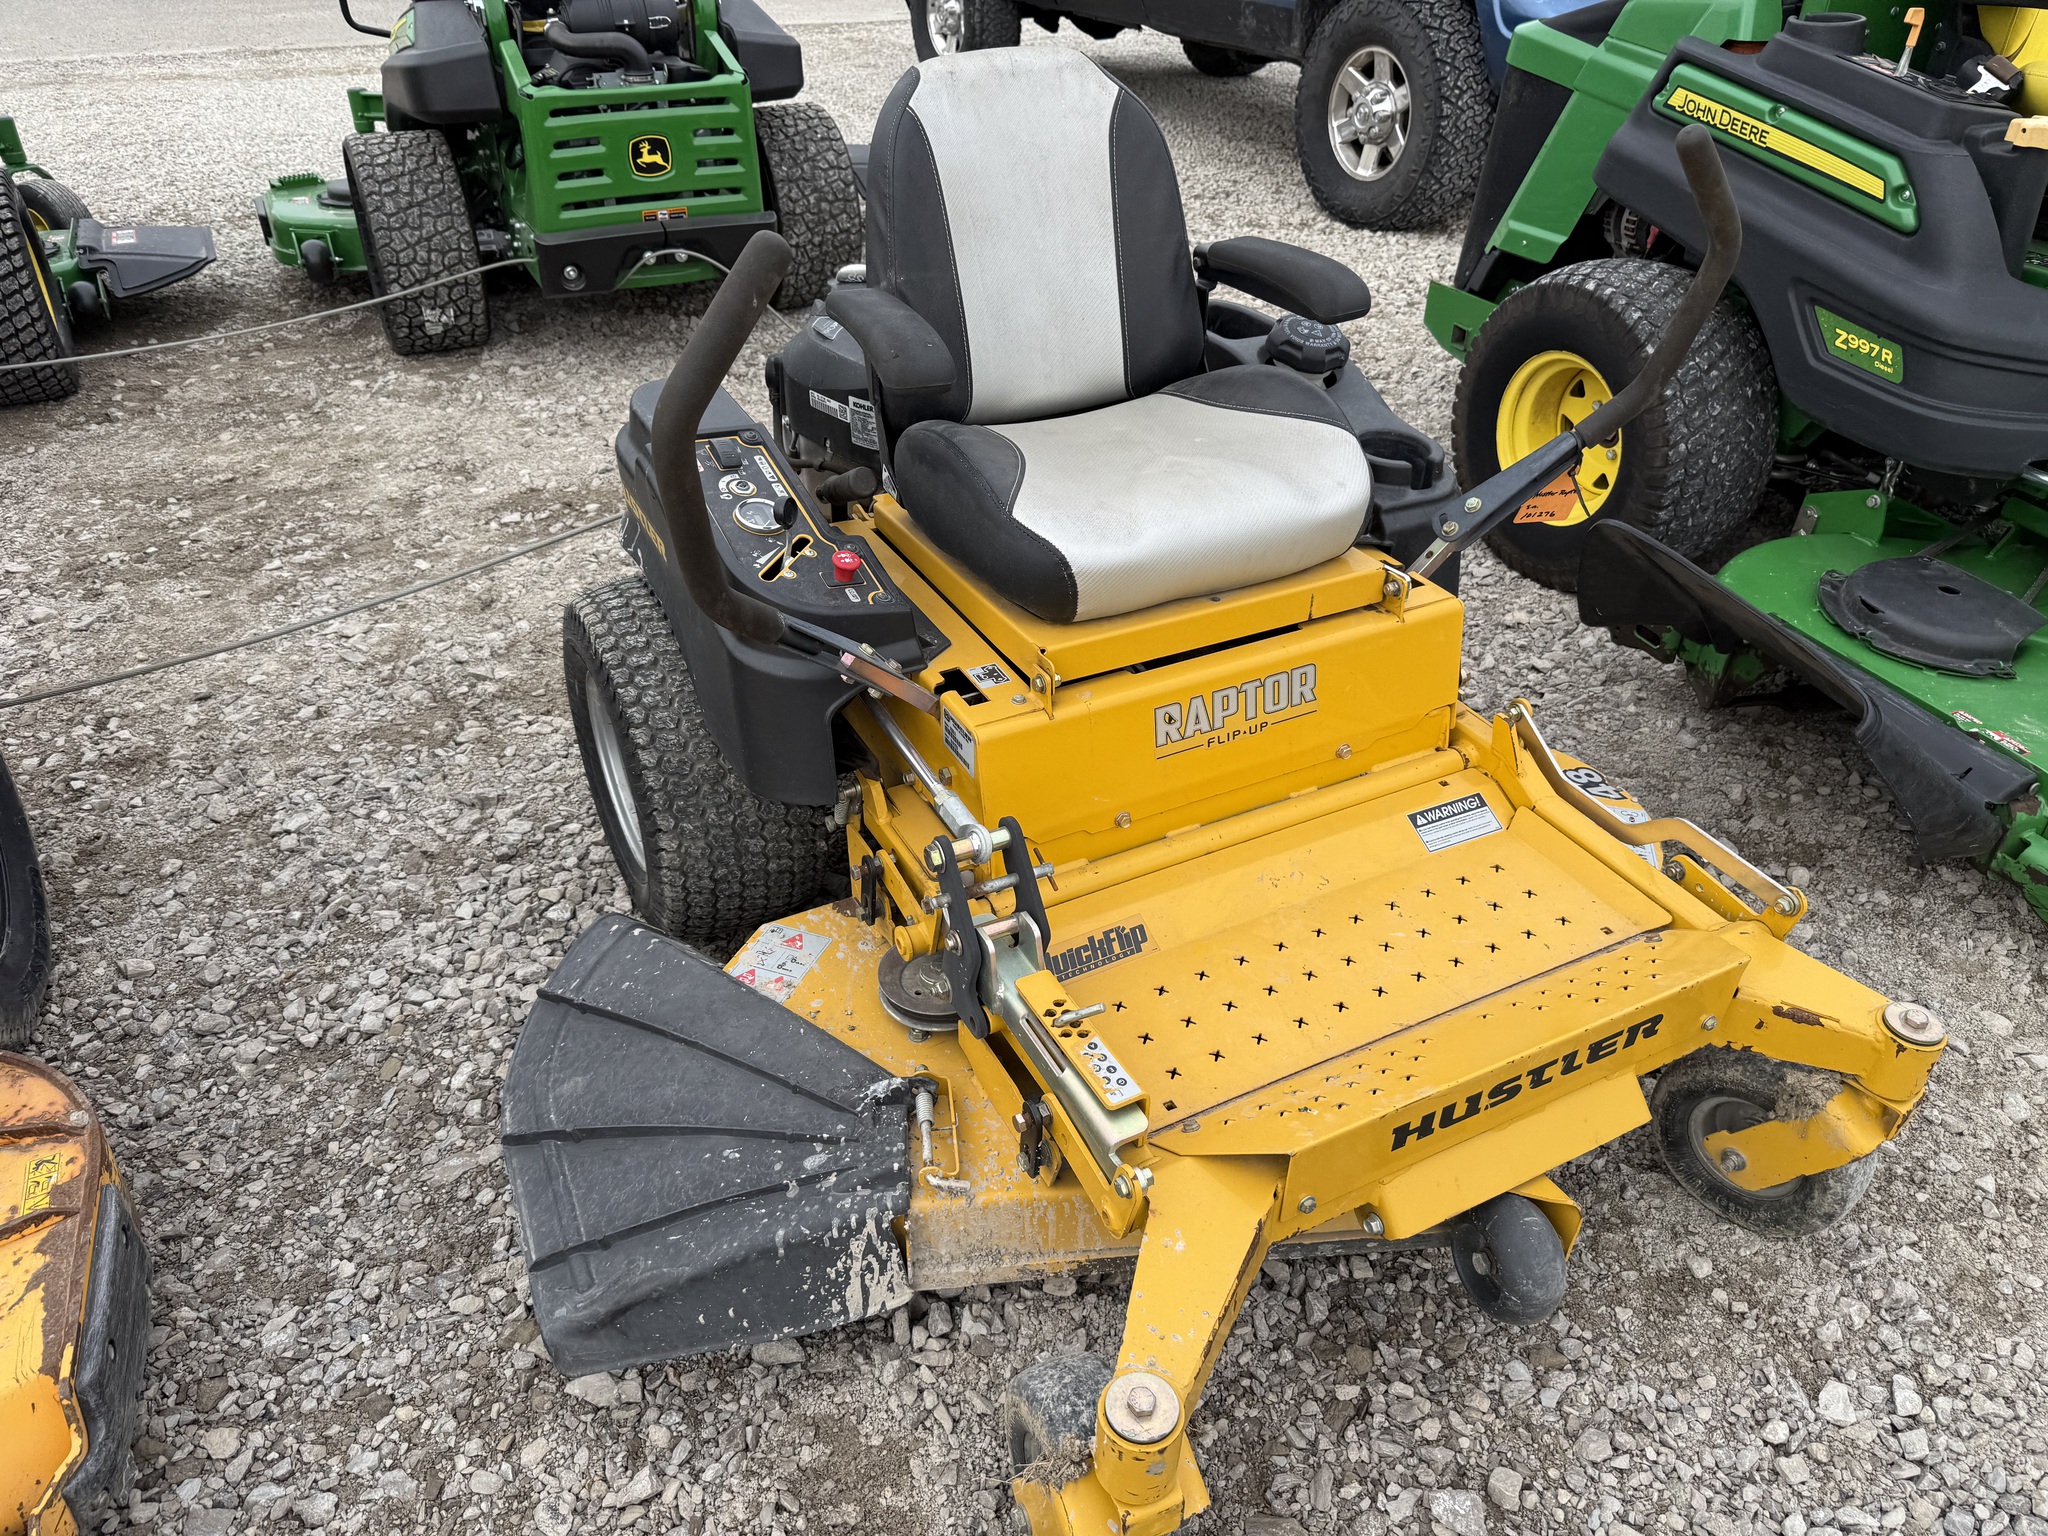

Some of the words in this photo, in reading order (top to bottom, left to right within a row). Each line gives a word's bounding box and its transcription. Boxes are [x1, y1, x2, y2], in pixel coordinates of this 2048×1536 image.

[1677, 94, 1717, 121] JOHN
[1719, 110, 1769, 145] DEERE
[852, 401, 875, 412] KOHLER
[1153, 663, 1317, 748] RAPTOR
[1424, 796, 1481, 822] WARNING!
[1391, 1013, 1664, 1152] HUSTLER
